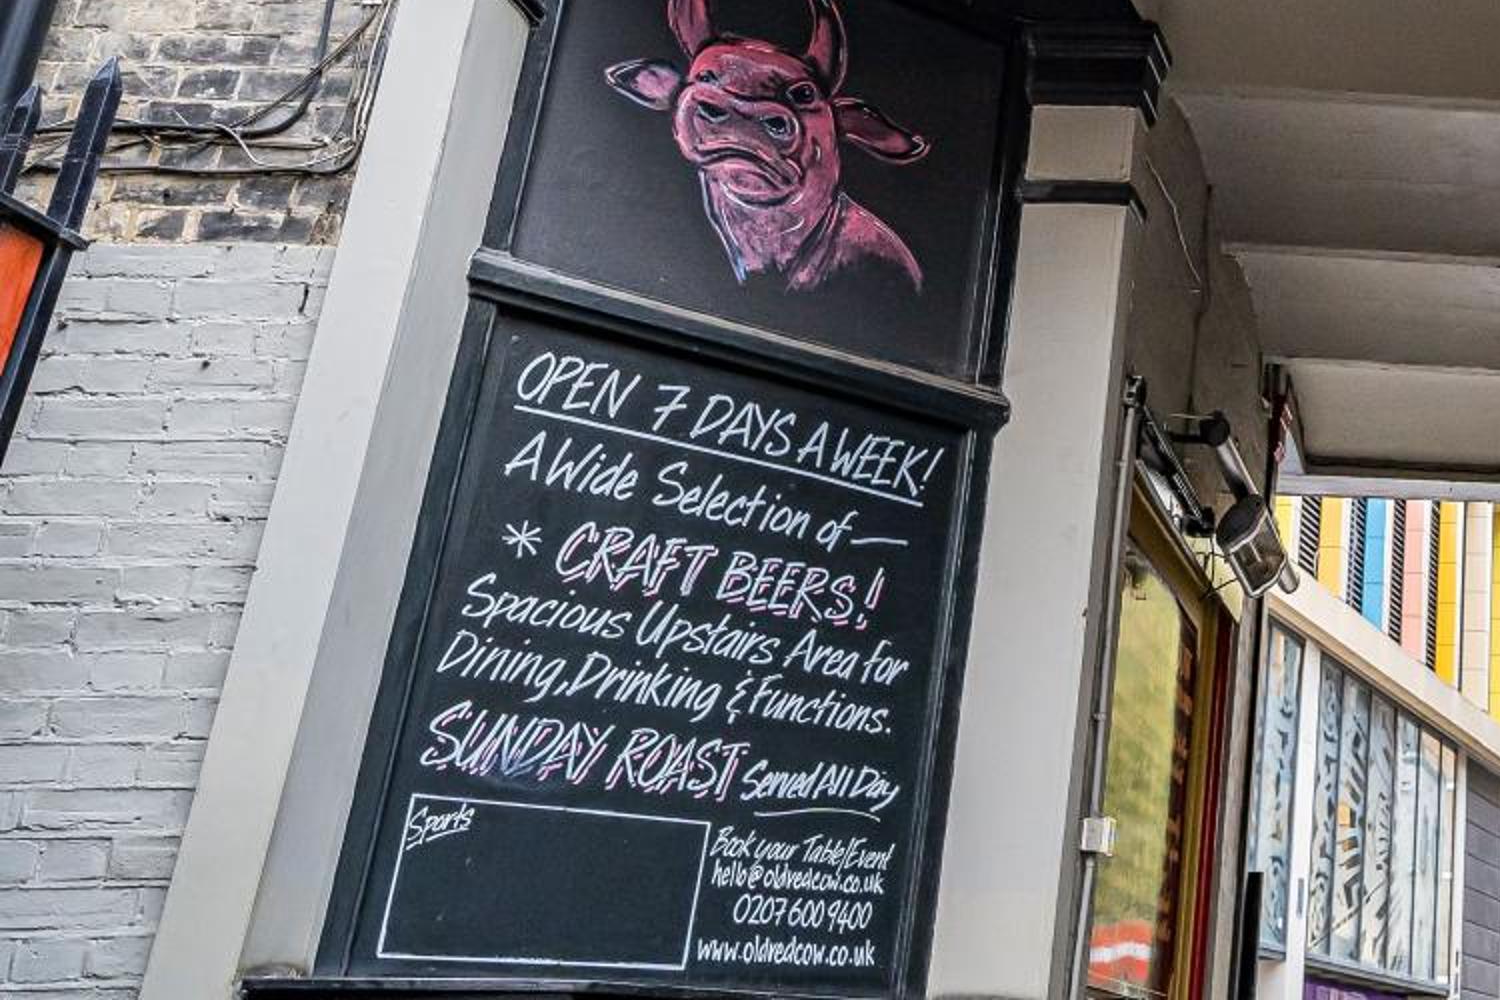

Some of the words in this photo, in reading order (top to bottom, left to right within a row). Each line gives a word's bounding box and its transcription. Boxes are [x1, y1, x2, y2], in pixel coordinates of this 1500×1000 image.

[517, 351, 642, 419] OPEN
[651, 384, 691, 432] 7
[690, 394, 797, 458] DAYS
[798, 421, 829, 469] A
[830, 426, 946, 498] WEEK!
[503, 430, 547, 481] A
[548, 436, 640, 502] Wide
[652, 460, 812, 541] Selection
[815, 509, 860, 553] of
[462, 572, 632, 640] Spacious
[635, 599, 782, 668] Upstairs
[783, 628, 858, 681] Area
[861, 639, 909, 687] for
[555, 521, 721, 597] CRAFT
[715, 550, 885, 631] BEERS!
[420, 699, 615, 784] SUNDAY
[605, 727, 750, 802] ROAST
[740, 760, 823, 800] Served
[812, 763, 855, 799] All
[849, 765, 900, 813] Day
[748, 671, 893, 736] Functions.
[406, 803, 475, 849] Sports
[710, 825, 756, 858] Book
[752, 838, 800, 866] your
[697, 935, 876, 967] www.oldredcow.co.uk
